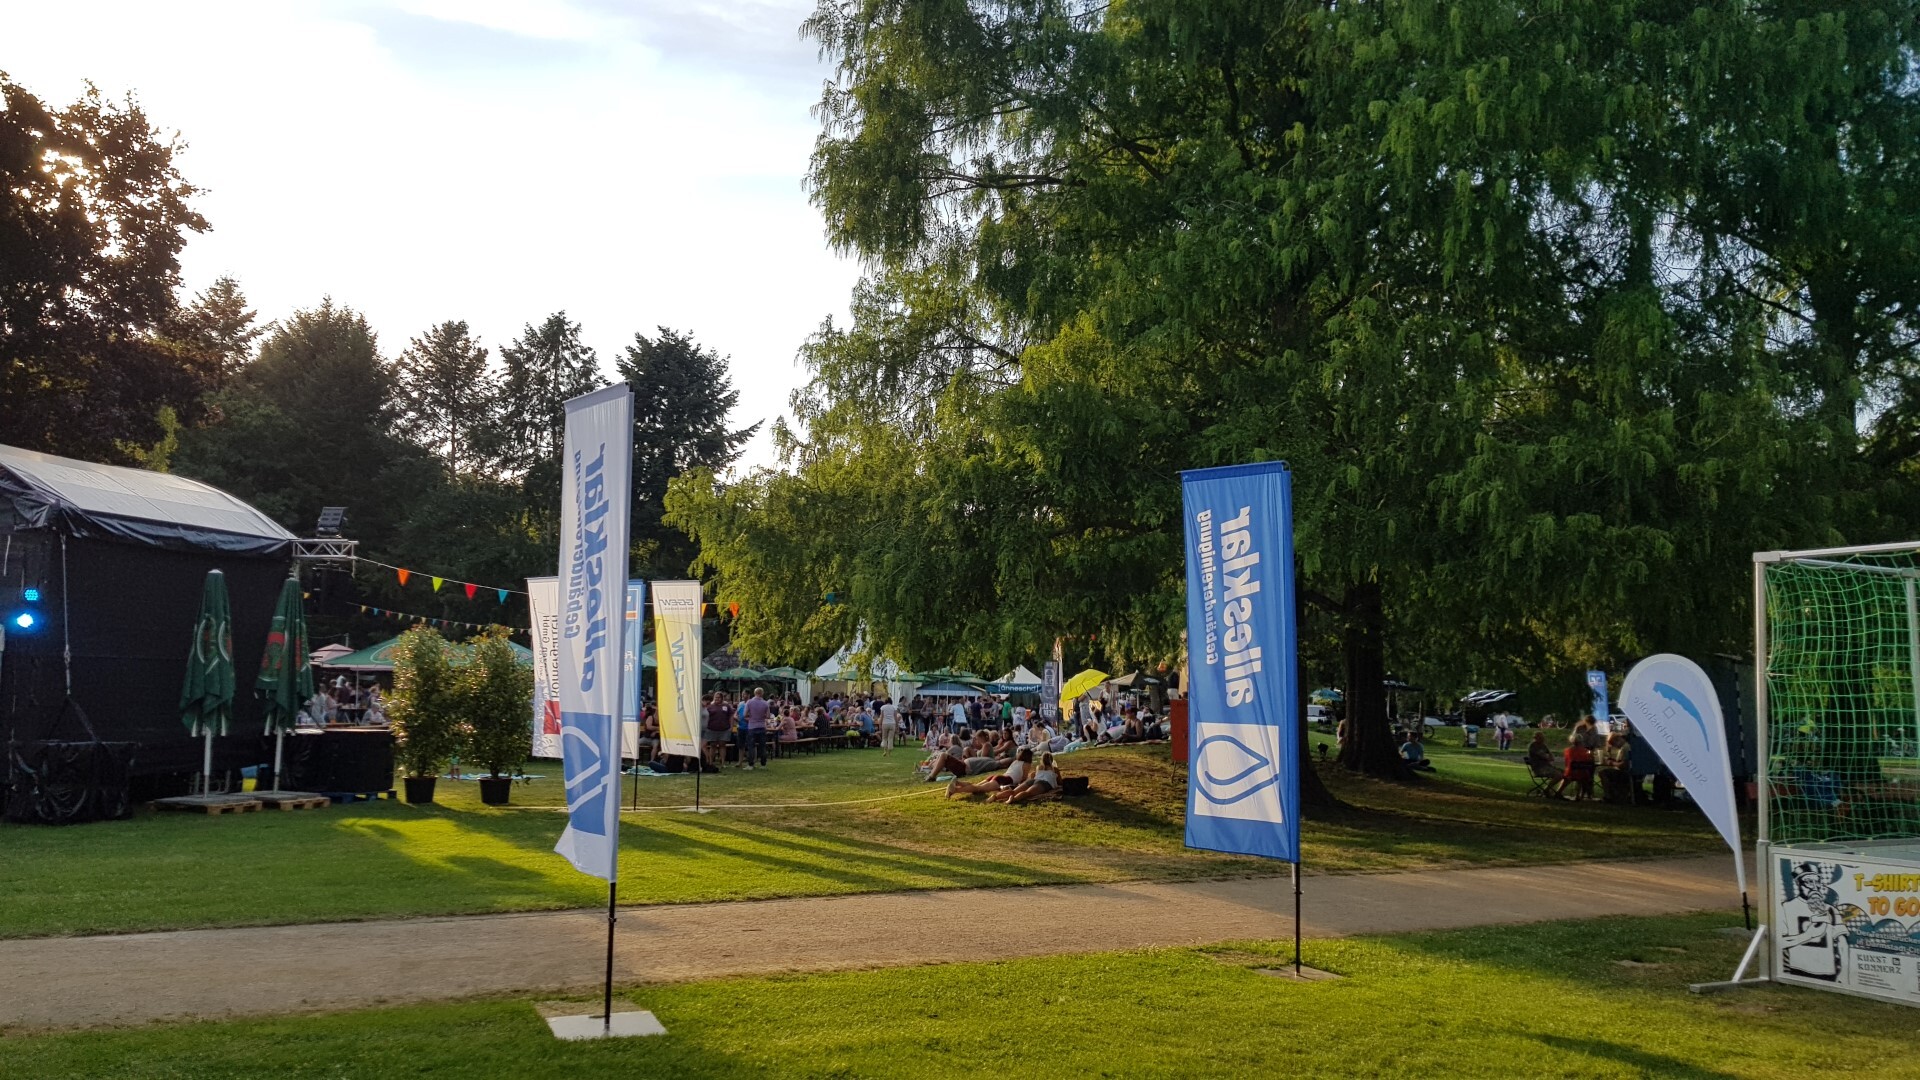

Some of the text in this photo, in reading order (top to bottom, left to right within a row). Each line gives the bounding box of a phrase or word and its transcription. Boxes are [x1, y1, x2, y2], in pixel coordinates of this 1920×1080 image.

[1853, 872, 1920, 892] T-SHIRT
[1867, 895, 1890, 916] TO
[1865, 940, 1920, 955] Darmstadt-Cit
[1857, 962, 1902, 975] KOMMERZ
